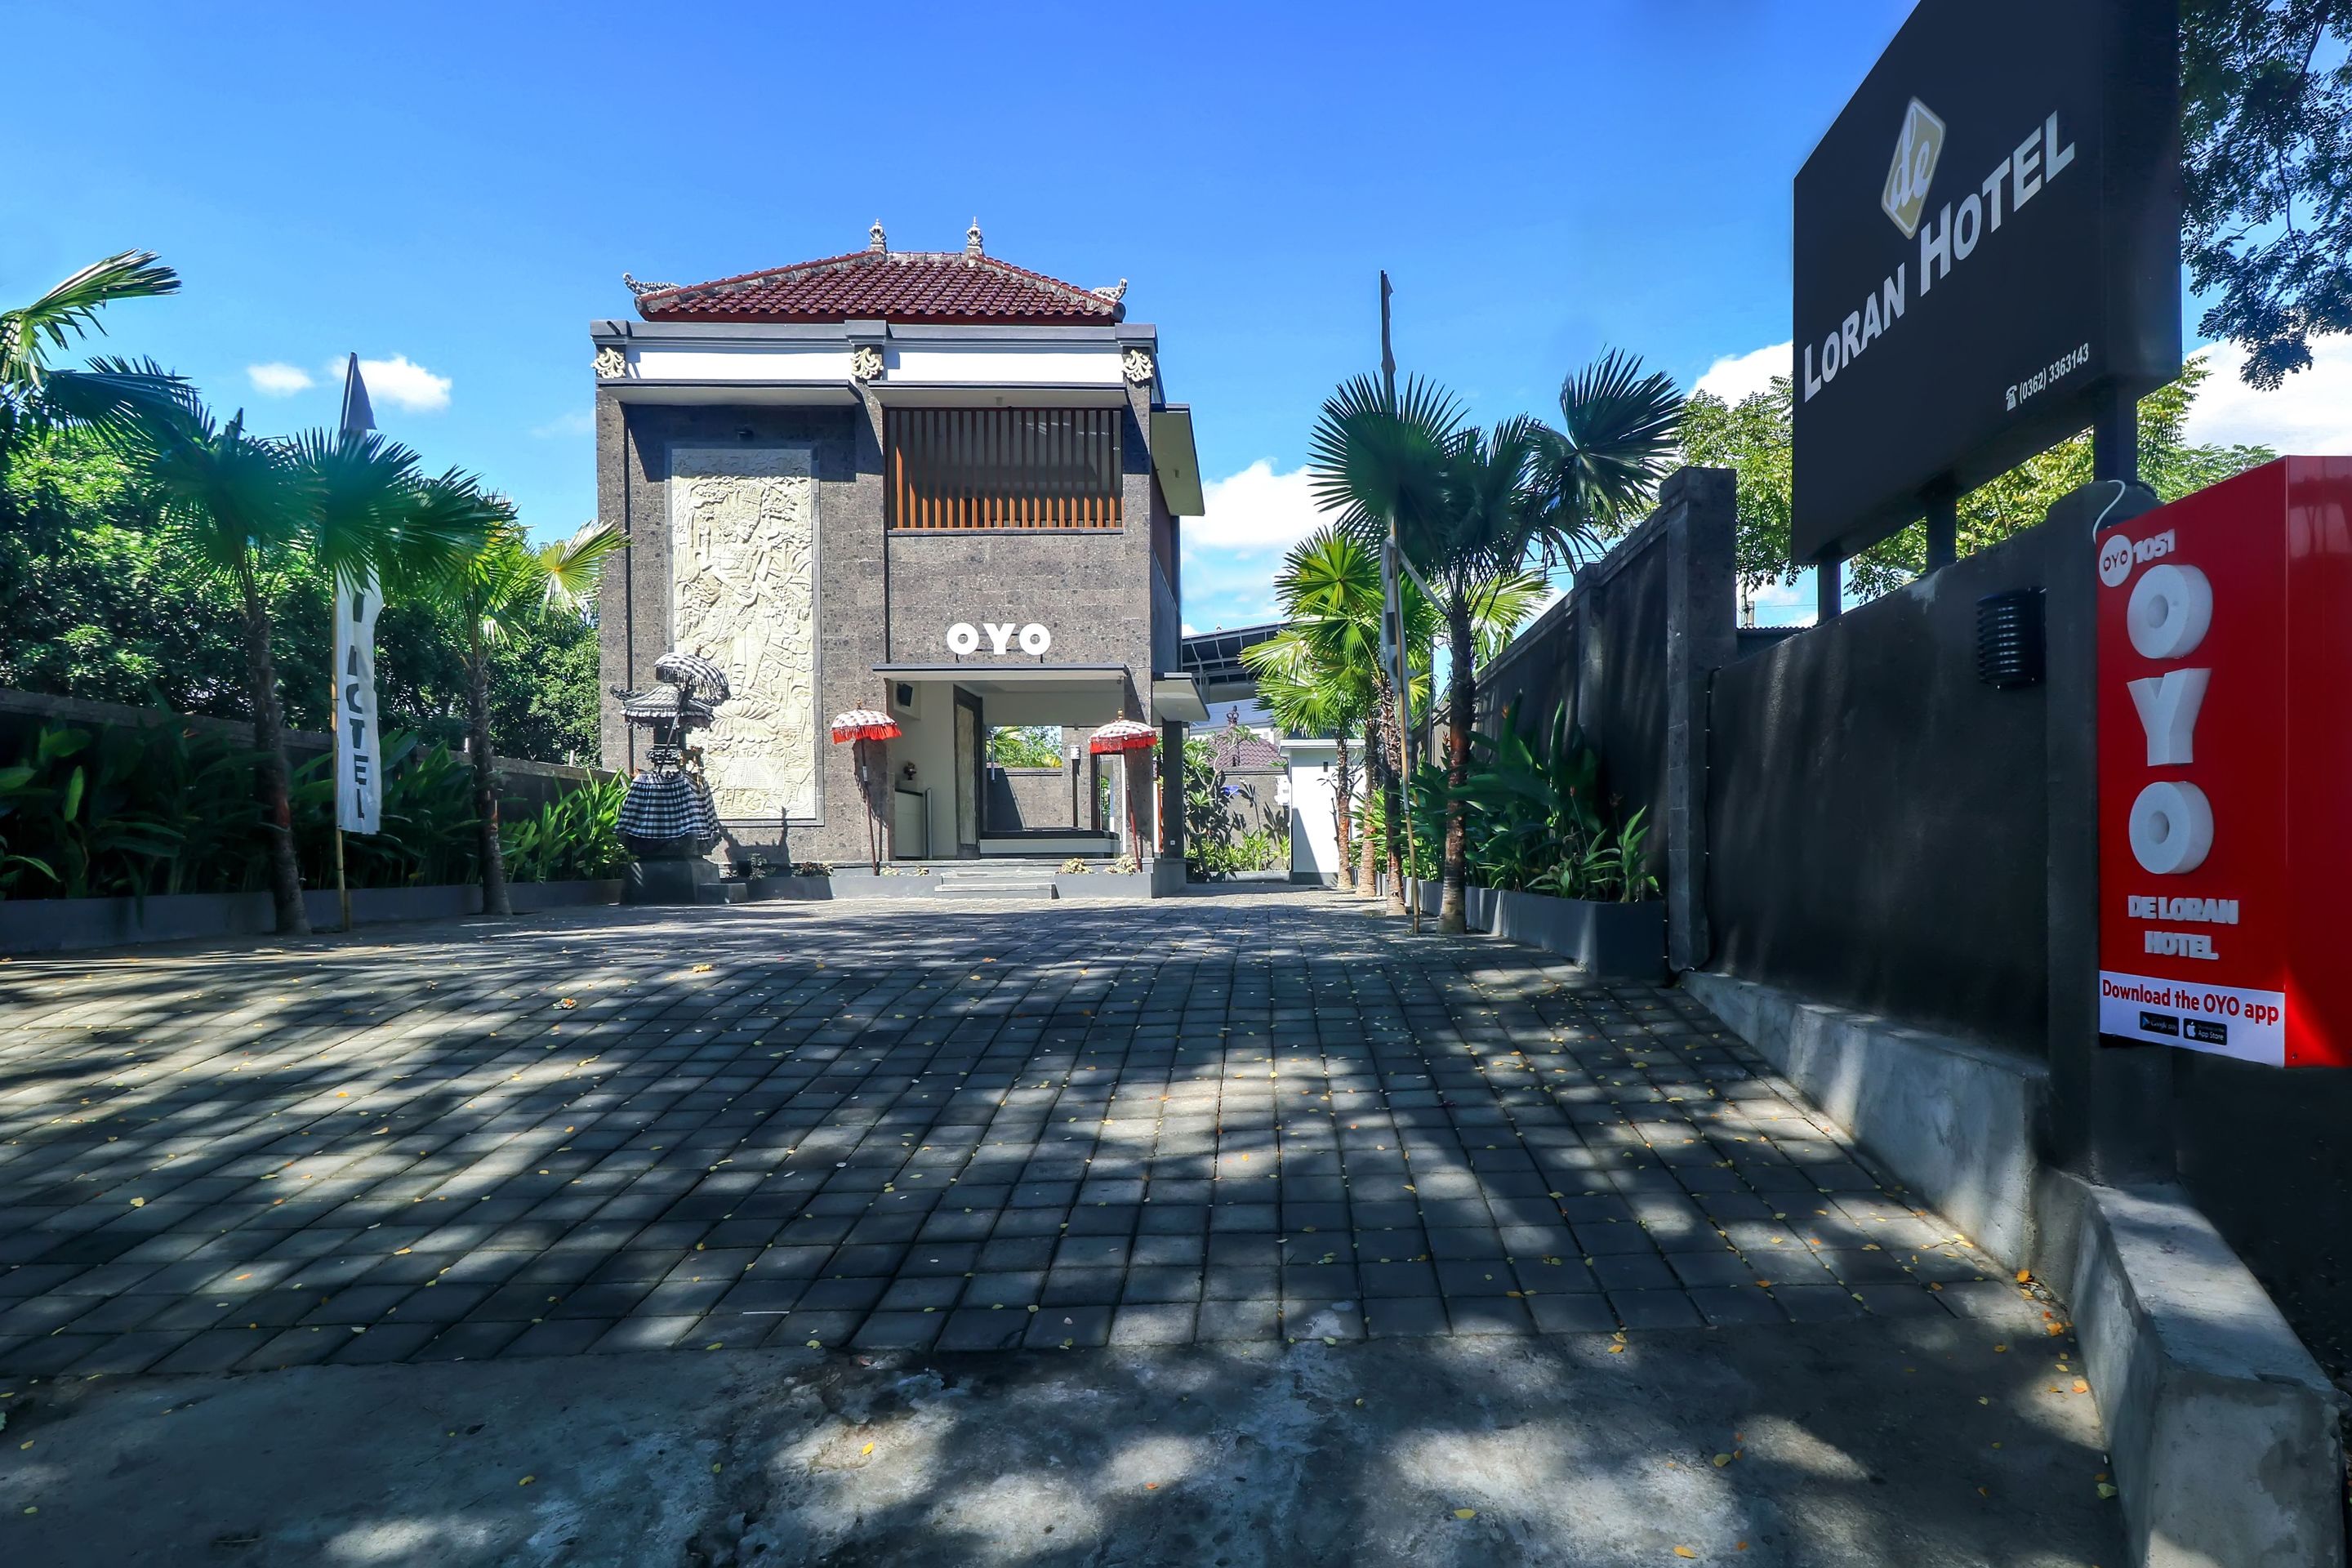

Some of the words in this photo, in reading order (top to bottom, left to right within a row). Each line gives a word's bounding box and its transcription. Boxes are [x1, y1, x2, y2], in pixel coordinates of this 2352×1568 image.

[1891, 104, 1930, 211] de
[1805, 262, 1905, 403] LORAN
[1921, 110, 2075, 297] HOTEL
[2020, 368, 2047, 403] (0362)
[2049, 343, 2089, 383] 3363143
[2104, 550, 2128, 572] OYO
[2133, 528, 2176, 564] 1051
[947, 622, 1051, 656] OYO
[2127, 564, 2214, 875] OYO
[2128, 895, 2157, 919] DE
[2158, 897, 2238, 924] LORAN
[2145, 930, 2220, 960] HOTEL
[2103, 979, 2171, 1007] Download
[2175, 990, 2199, 1010] the
[2203, 993, 2239, 1016] OYO
[2244, 1003, 2279, 1026] app
[2198, 1030, 2209, 1038] App
[2210, 1031, 2225, 1040] Store
